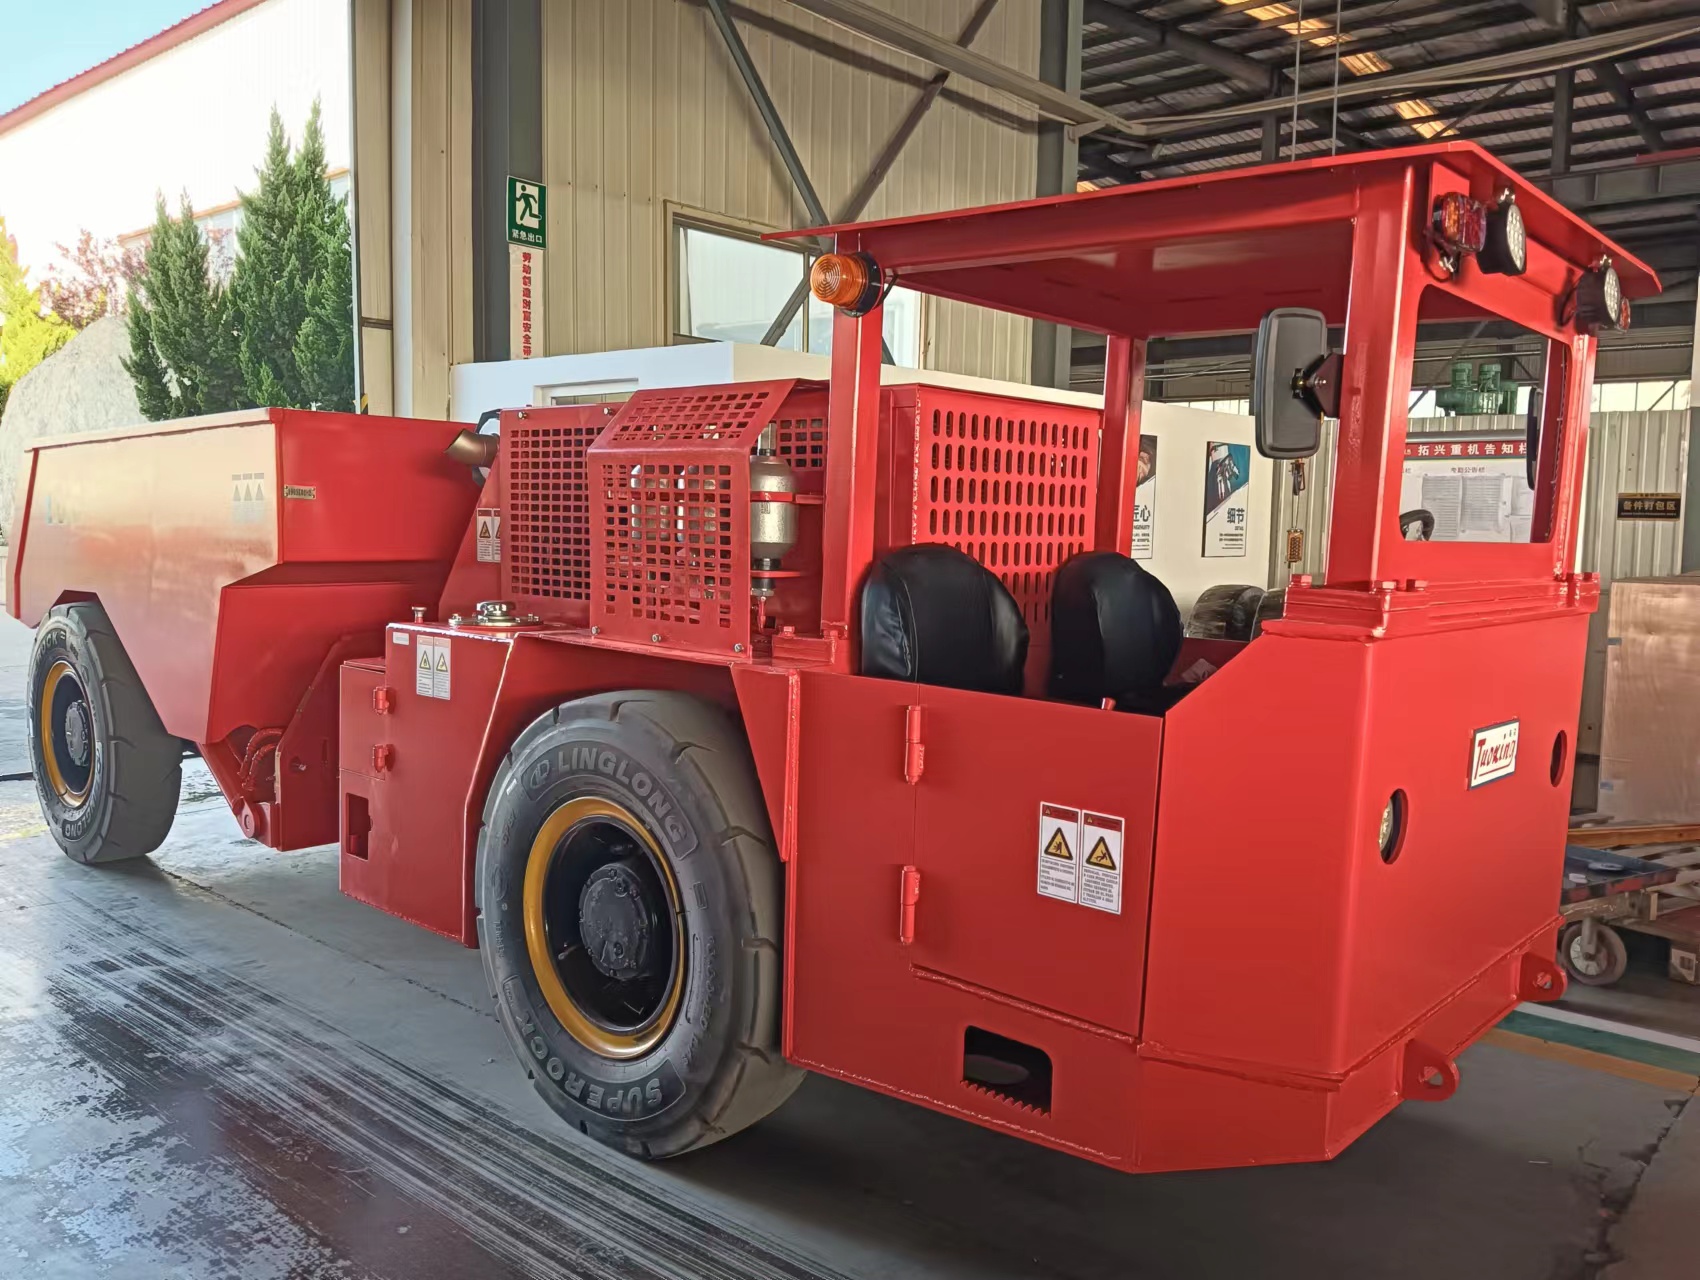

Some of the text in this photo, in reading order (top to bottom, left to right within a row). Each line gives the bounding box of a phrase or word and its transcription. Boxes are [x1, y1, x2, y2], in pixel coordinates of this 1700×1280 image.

[512, 229, 543, 243] 紧急出口
[522, 252, 532, 359] 劳动创造财富安全带
[1226, 507, 1246, 525] 细节
[557, 747, 688, 844] LINGLONG
